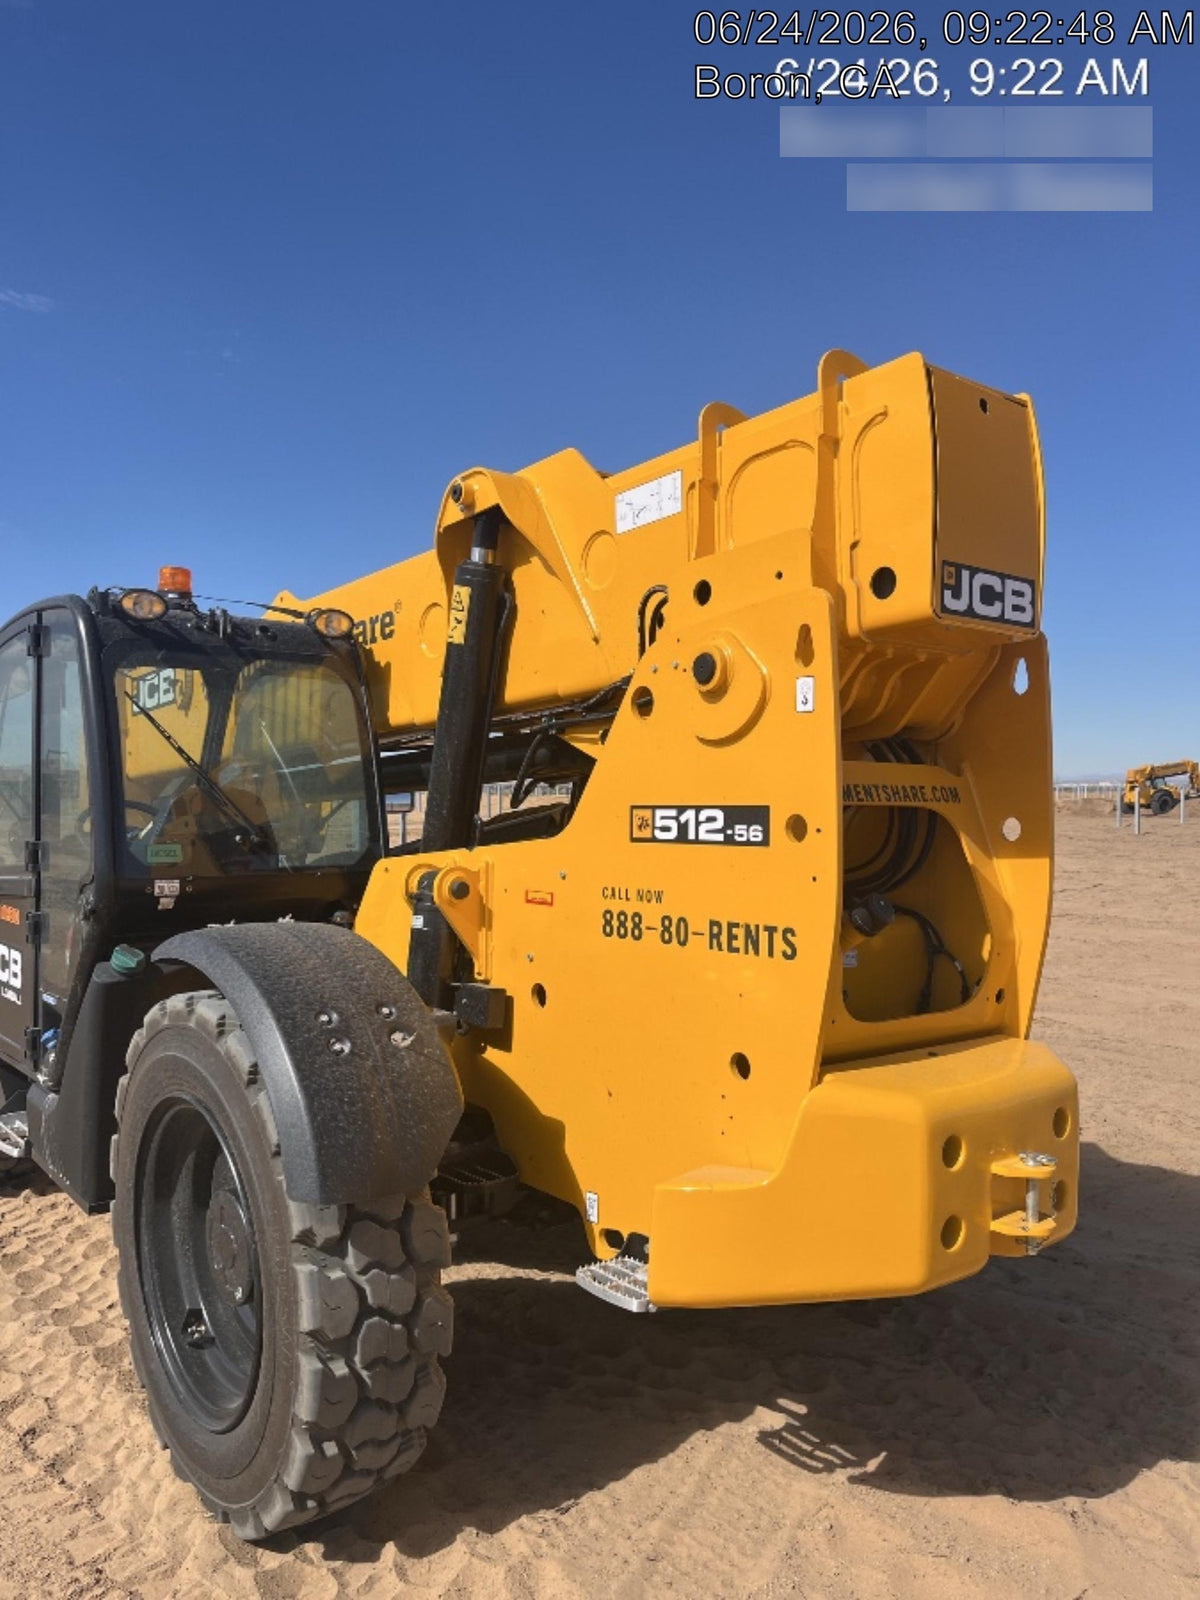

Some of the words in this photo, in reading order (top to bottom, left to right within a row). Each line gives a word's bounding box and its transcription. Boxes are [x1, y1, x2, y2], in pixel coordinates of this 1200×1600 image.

[943, 568, 1033, 623] JCB
[602, 886, 631, 902] CALL
[636, 888, 664, 904] NOW
[602, 909, 798, 961] 888-80-RENTS
